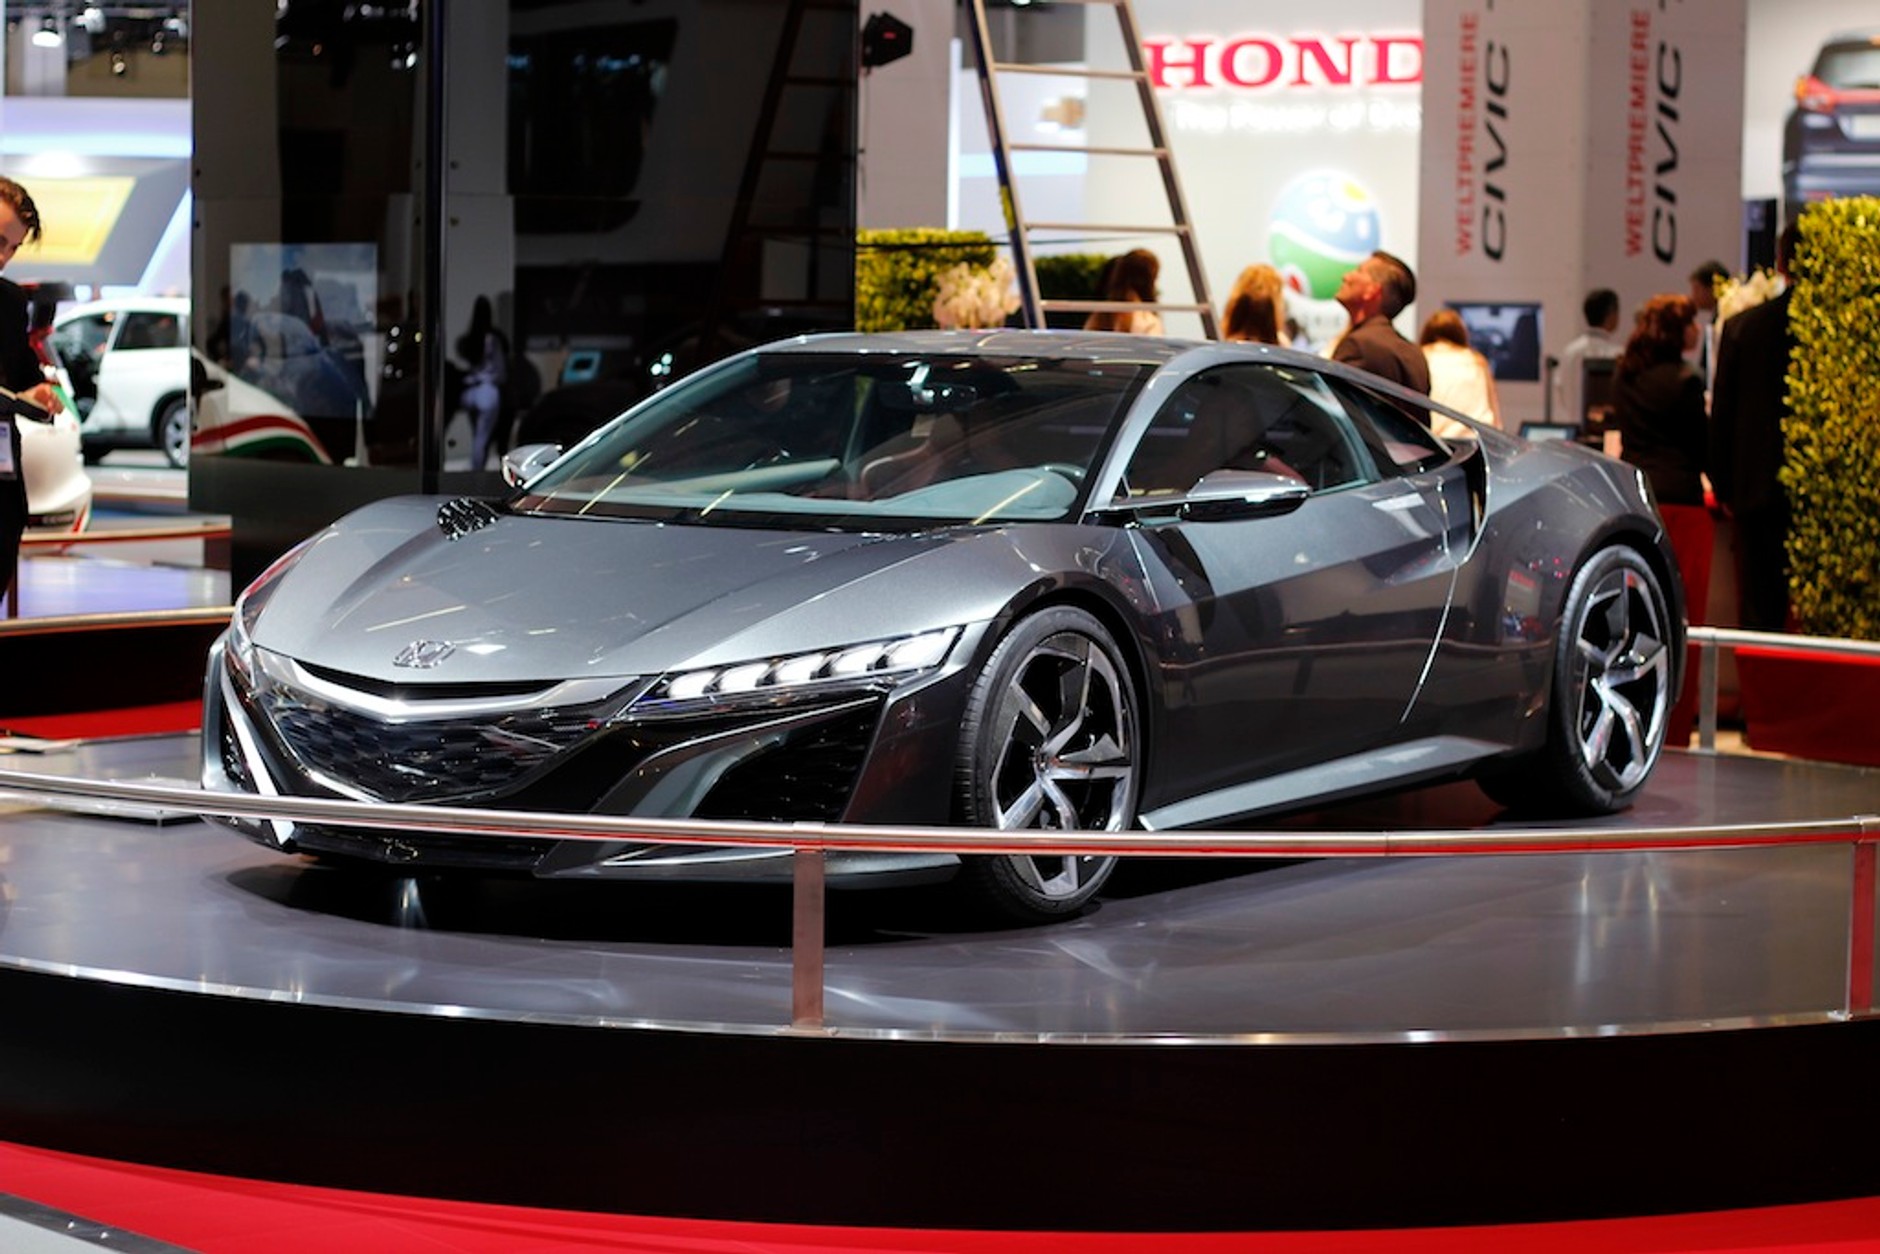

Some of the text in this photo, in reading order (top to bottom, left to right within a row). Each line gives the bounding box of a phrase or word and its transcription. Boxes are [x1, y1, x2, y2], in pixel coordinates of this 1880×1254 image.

[1456, 12, 1479, 256] WELTPREMIERE
[1482, 41, 1510, 261] CIVIC
[1626, 10, 1650, 256] WELTPREMIERE
[1652, 41, 1682, 264] CIVIC
